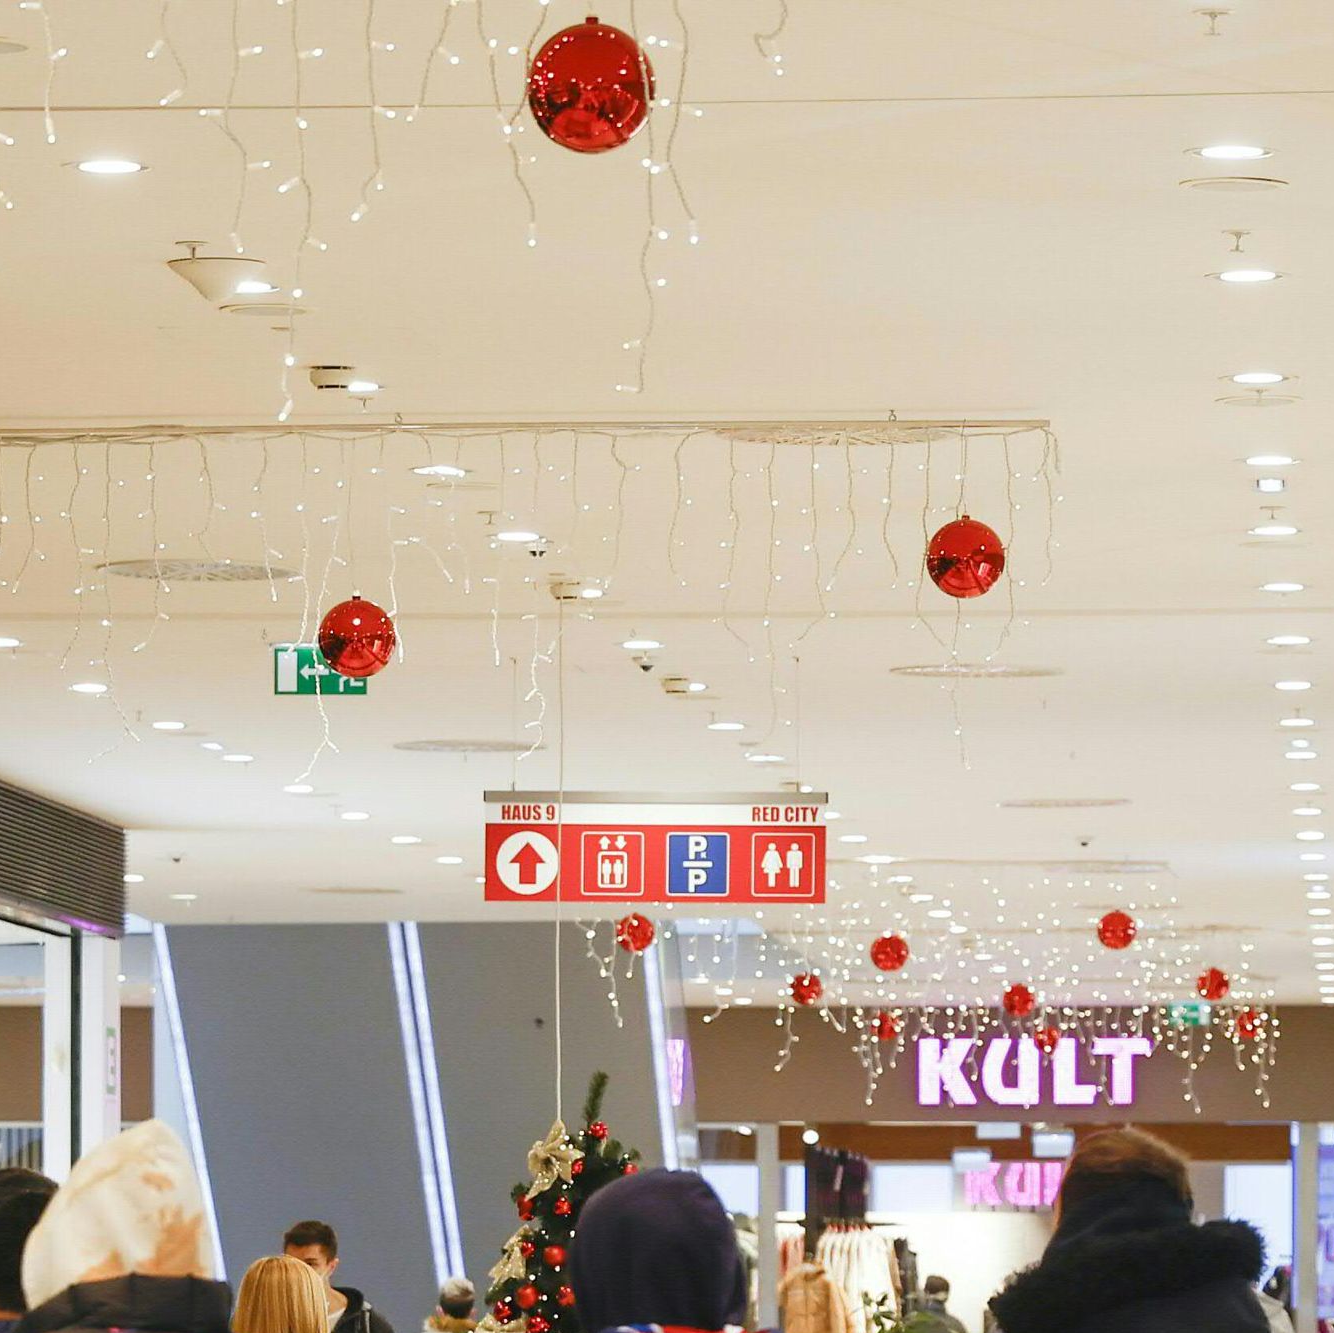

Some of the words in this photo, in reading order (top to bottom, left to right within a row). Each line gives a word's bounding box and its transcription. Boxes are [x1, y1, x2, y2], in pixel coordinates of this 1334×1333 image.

[501, 804, 542, 821] HAUS
[545, 804, 556, 821] 9
[751, 806, 783, 822] RED
[784, 806, 819, 823] CITY
[918, 1037, 1152, 1106] KULT
